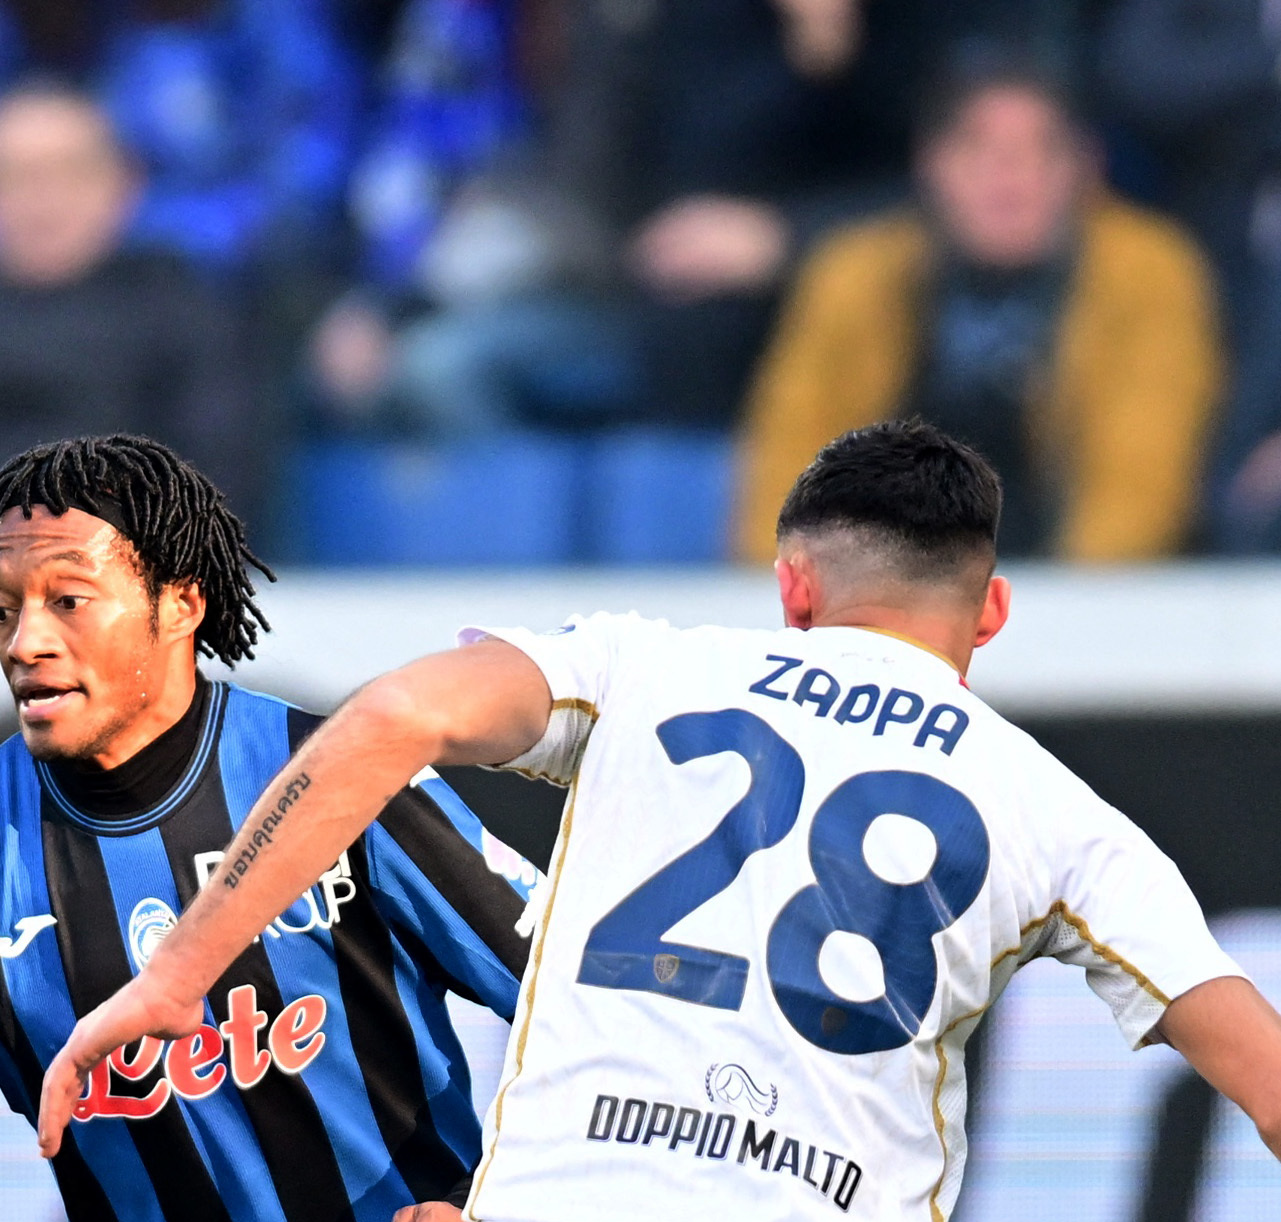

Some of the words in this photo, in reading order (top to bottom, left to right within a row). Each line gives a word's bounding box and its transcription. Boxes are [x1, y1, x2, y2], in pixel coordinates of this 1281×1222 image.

[748, 653, 970, 757] ZAPPA
[575, 707, 991, 1055] 28
[72, 983, 328, 1122] Lete
[586, 1094, 738, 1162] DOPPIO
[736, 1118, 864, 1214] MALTO
